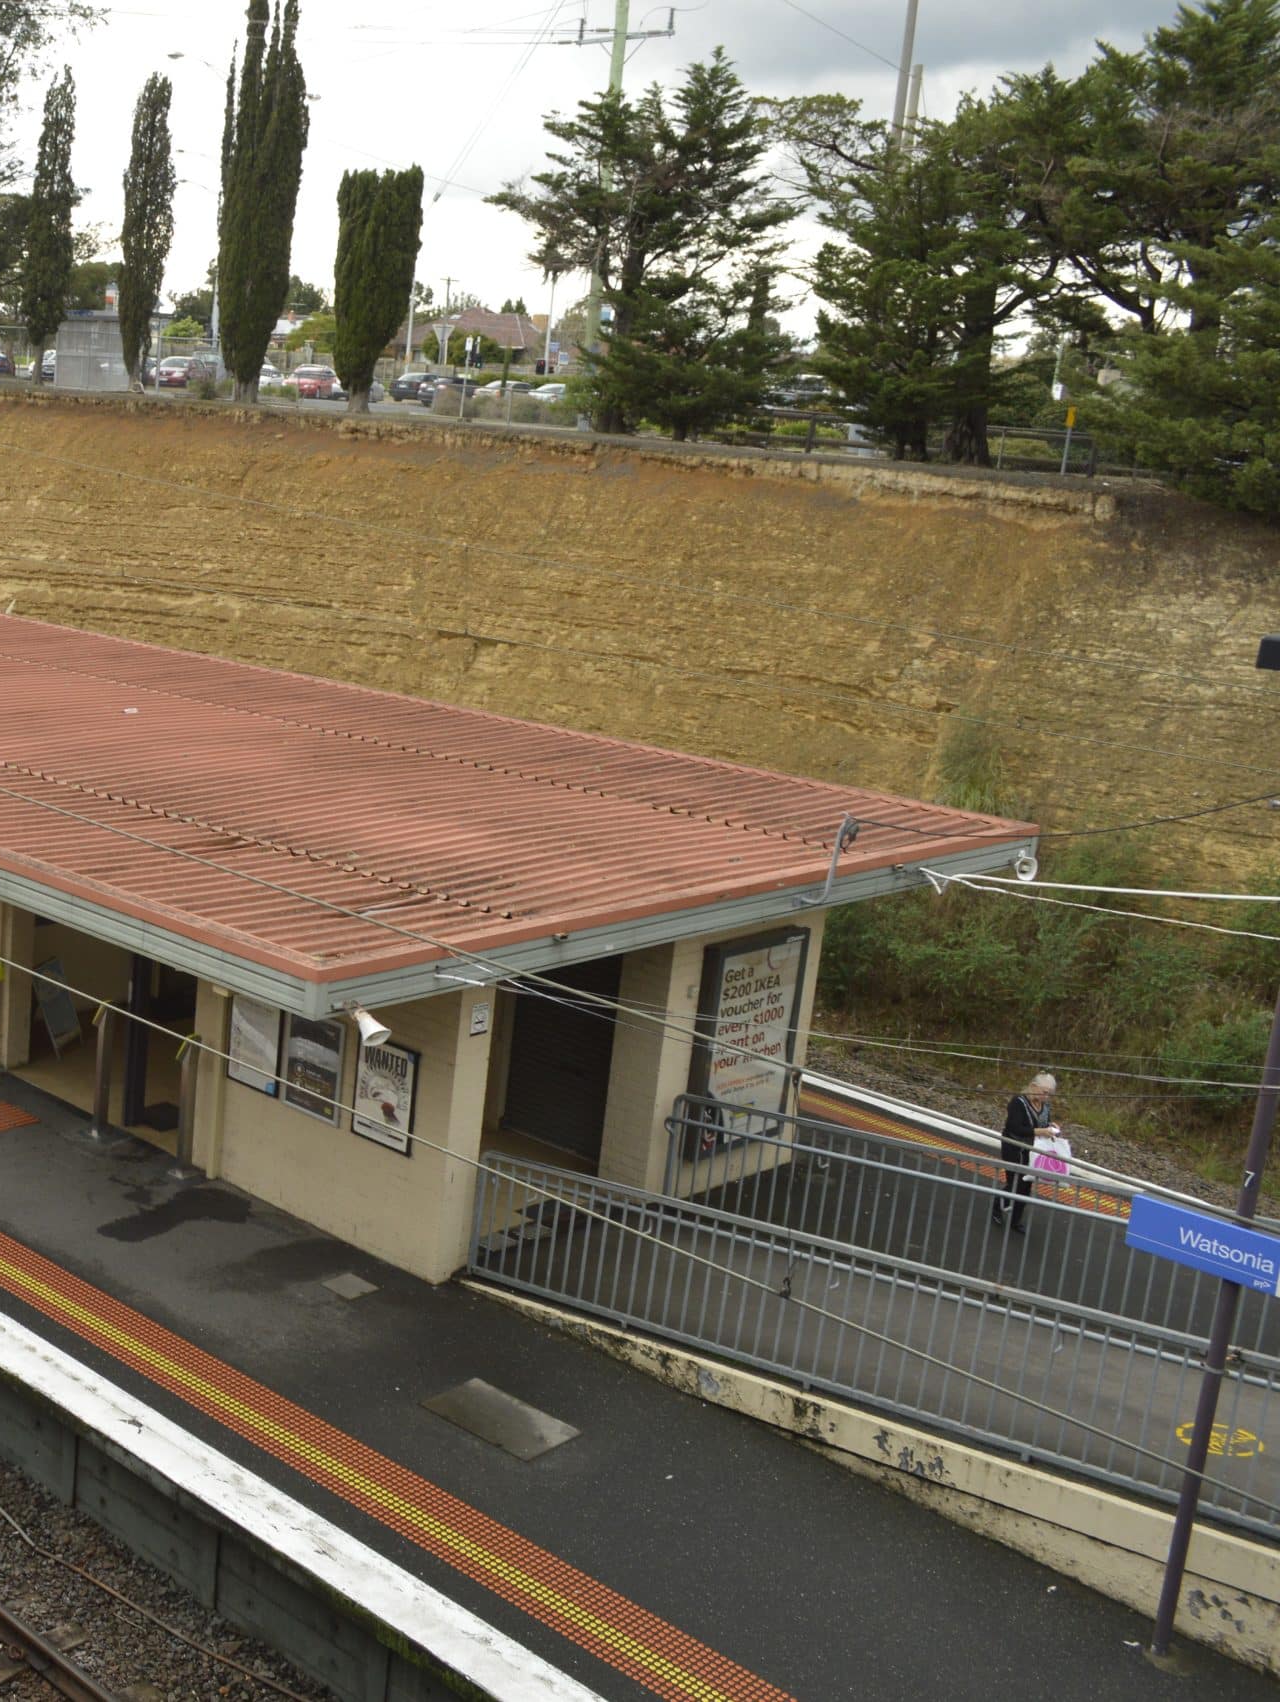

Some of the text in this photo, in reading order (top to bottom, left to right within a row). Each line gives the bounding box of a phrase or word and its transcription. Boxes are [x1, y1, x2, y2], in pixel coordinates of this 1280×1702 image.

[722, 974, 781, 1001] $200 IKEA
[725, 967, 755, 983] Get a
[720, 991, 783, 1018] voucher for
[718, 1005, 785, 1036] every $1000
[752, 1031, 765, 1045] on
[365, 1046, 408, 1078] WANTED
[713, 1055, 738, 1074] your
[1244, 1170, 1255, 1188] 7
[1179, 1226, 1274, 1274] Watsonia
